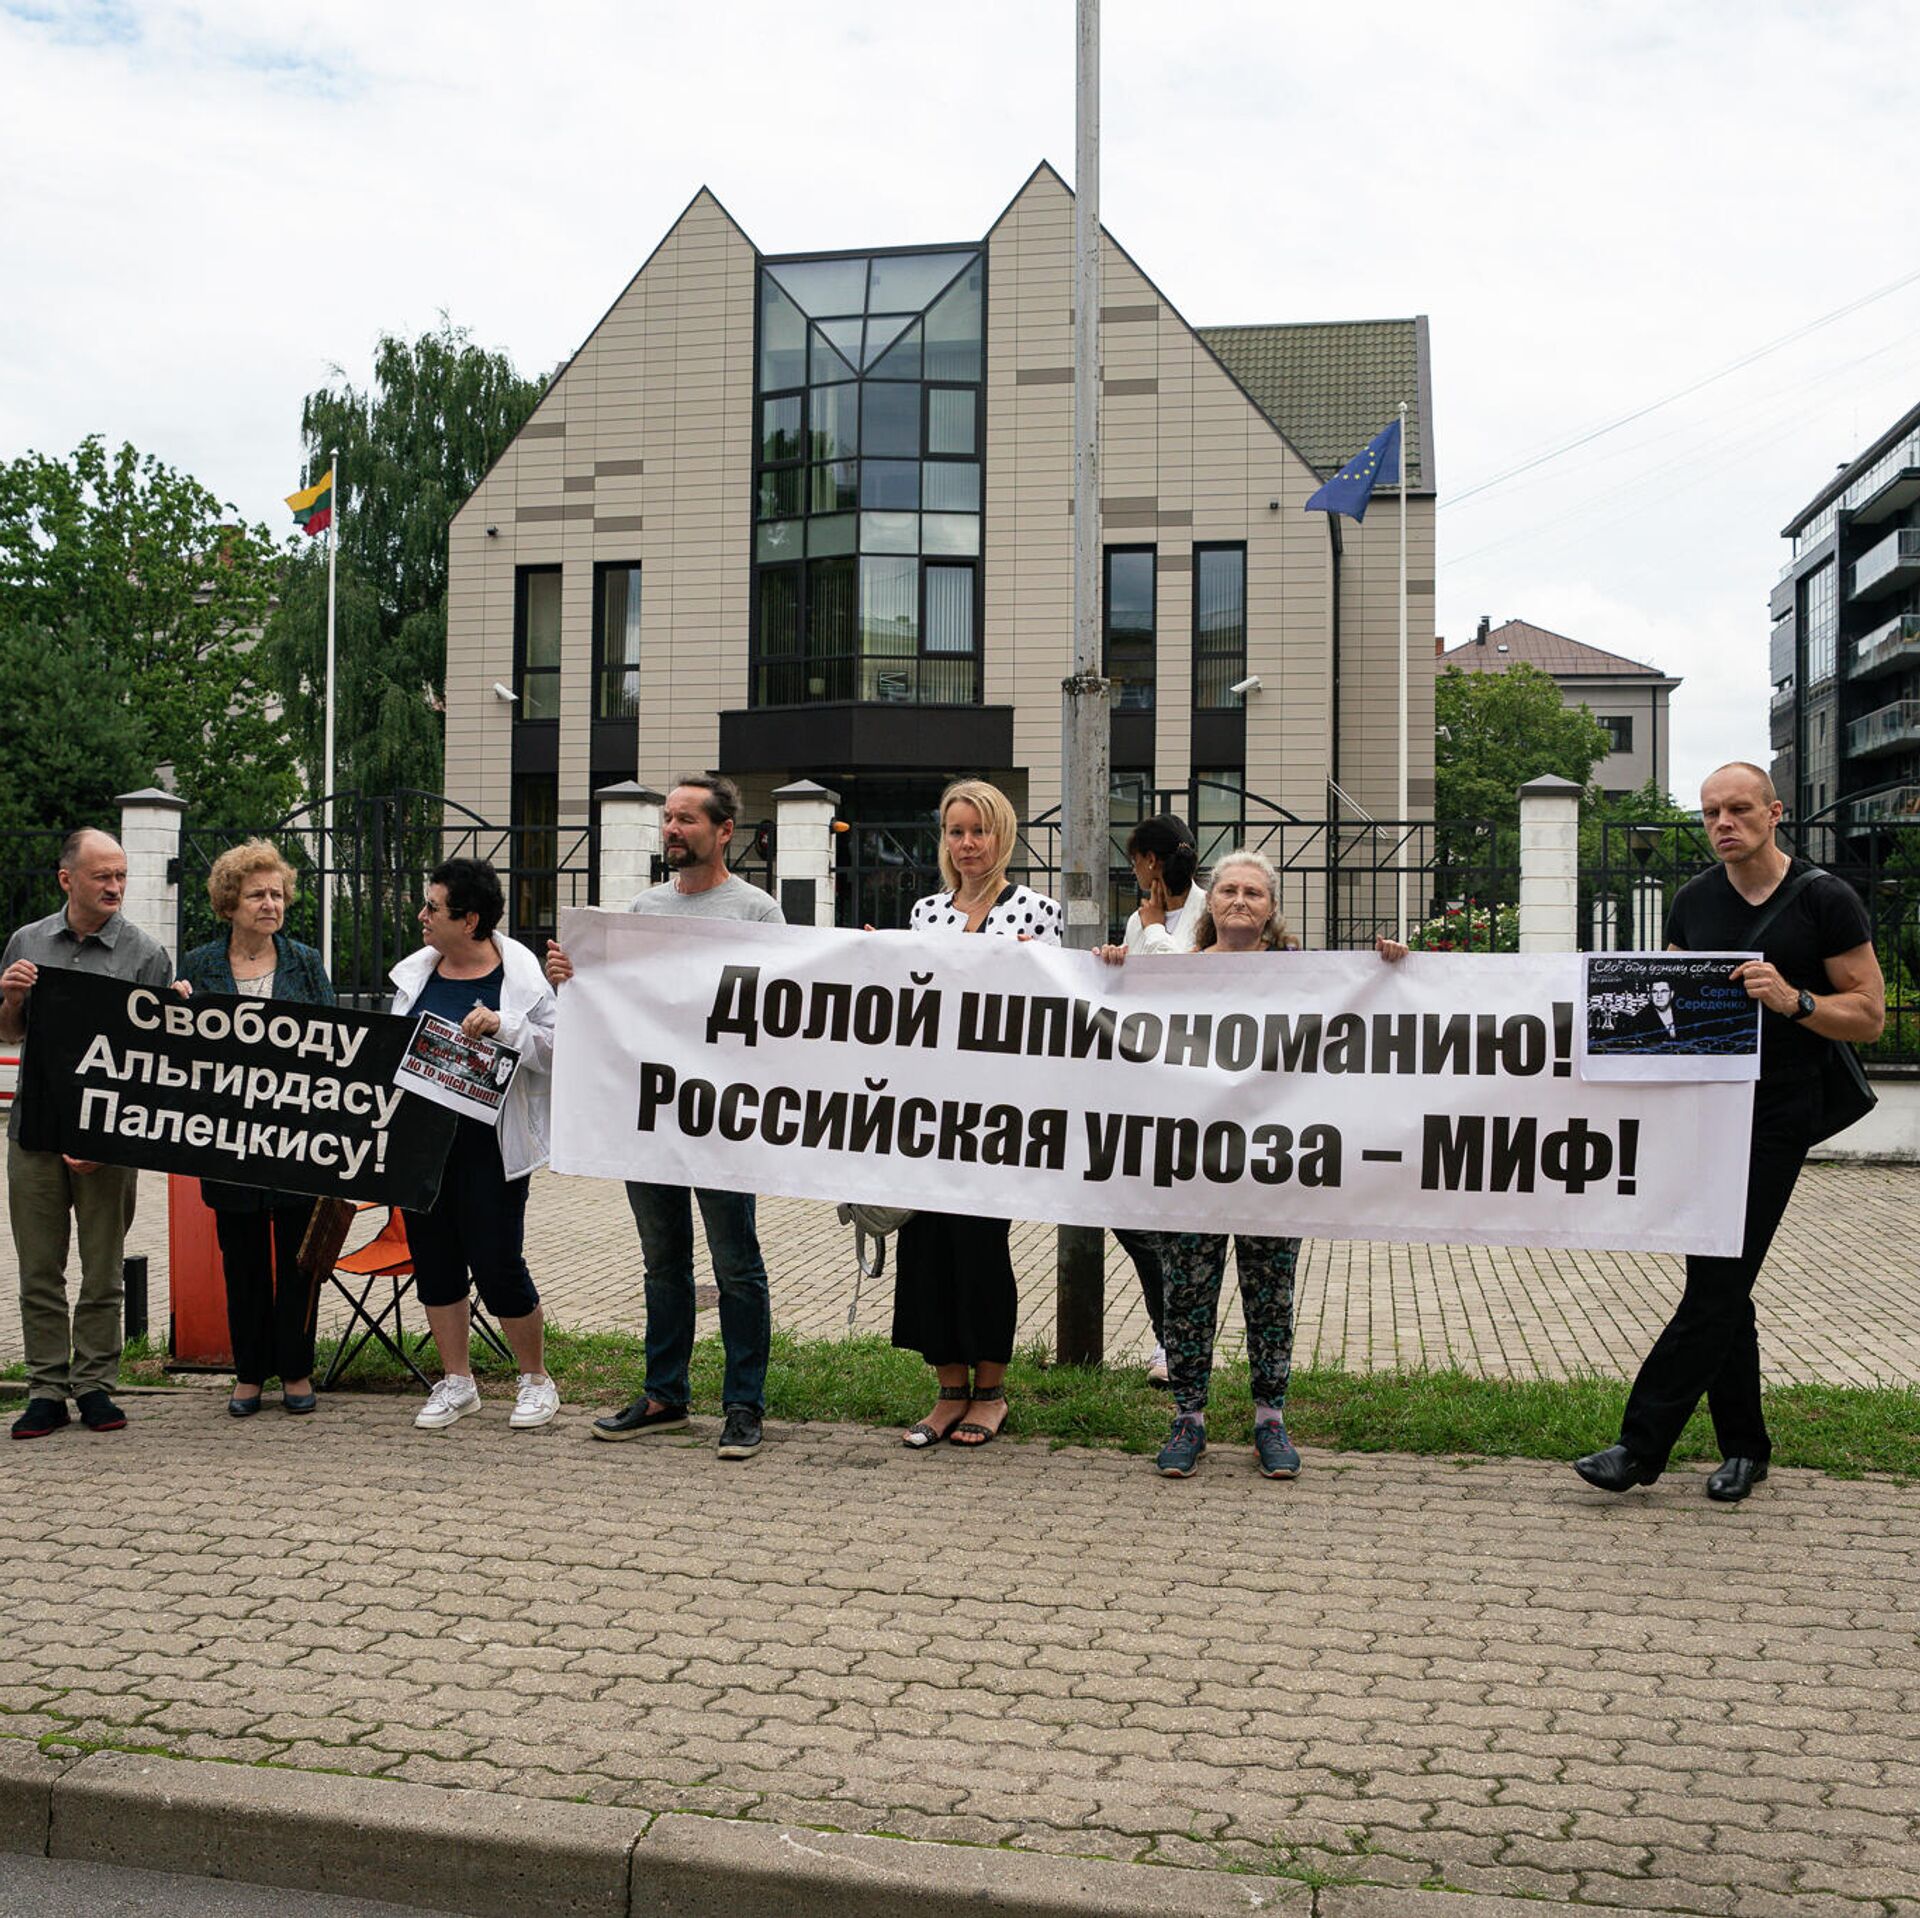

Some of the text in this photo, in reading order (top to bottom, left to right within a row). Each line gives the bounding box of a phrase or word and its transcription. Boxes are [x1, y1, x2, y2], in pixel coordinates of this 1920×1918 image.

[1675, 998, 1748, 1011] Середенко
[1690, 960, 1736, 974] совест
[128, 989, 369, 1068] Свободу
[706, 966, 1574, 1078] Долой шпиономанию!
[75, 1034, 405, 1129] Альгирдасу
[406, 1056, 499, 1104] No to witch hunt!
[79, 1087, 389, 1180] Палецкису!
[637, 1062, 1068, 1171] Российская
[1083, 1112, 1342, 1188] угроза
